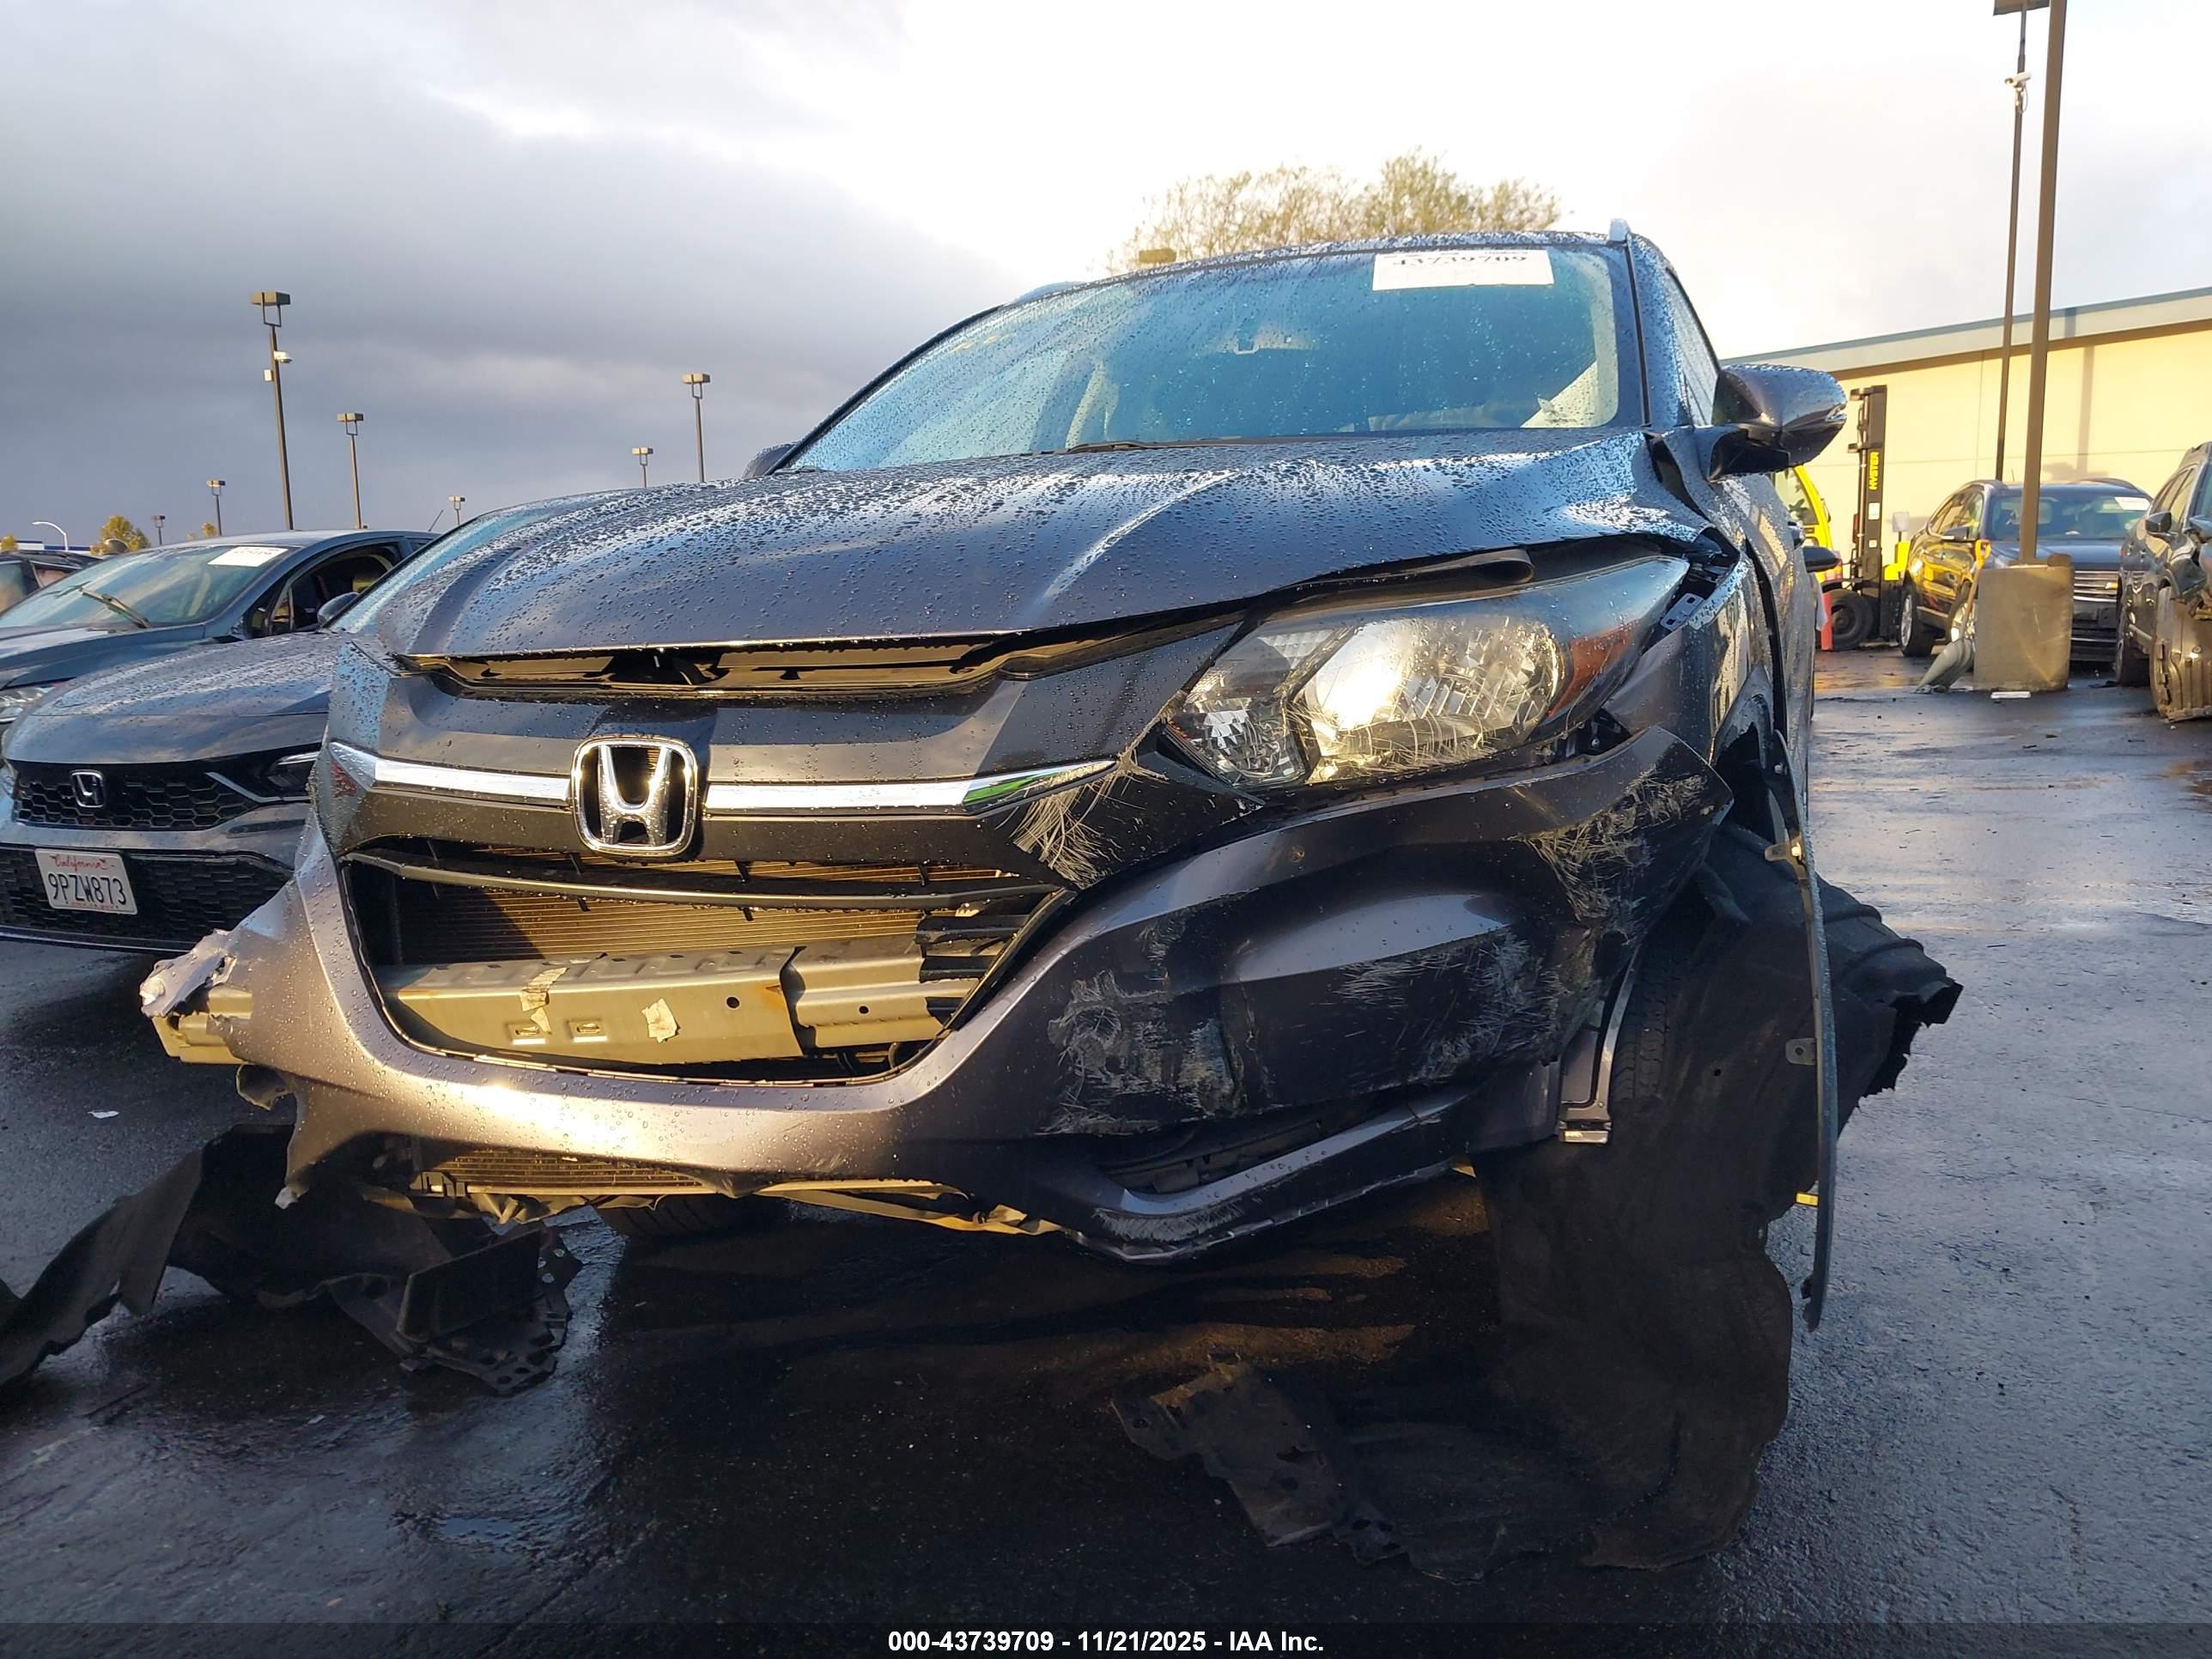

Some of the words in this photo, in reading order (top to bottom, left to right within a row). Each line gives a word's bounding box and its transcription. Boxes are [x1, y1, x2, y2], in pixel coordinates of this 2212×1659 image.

[1869, 452, 1880, 490] HYSTER
[52, 854, 107, 872] California
[48, 873, 127, 905] 9PZW873
